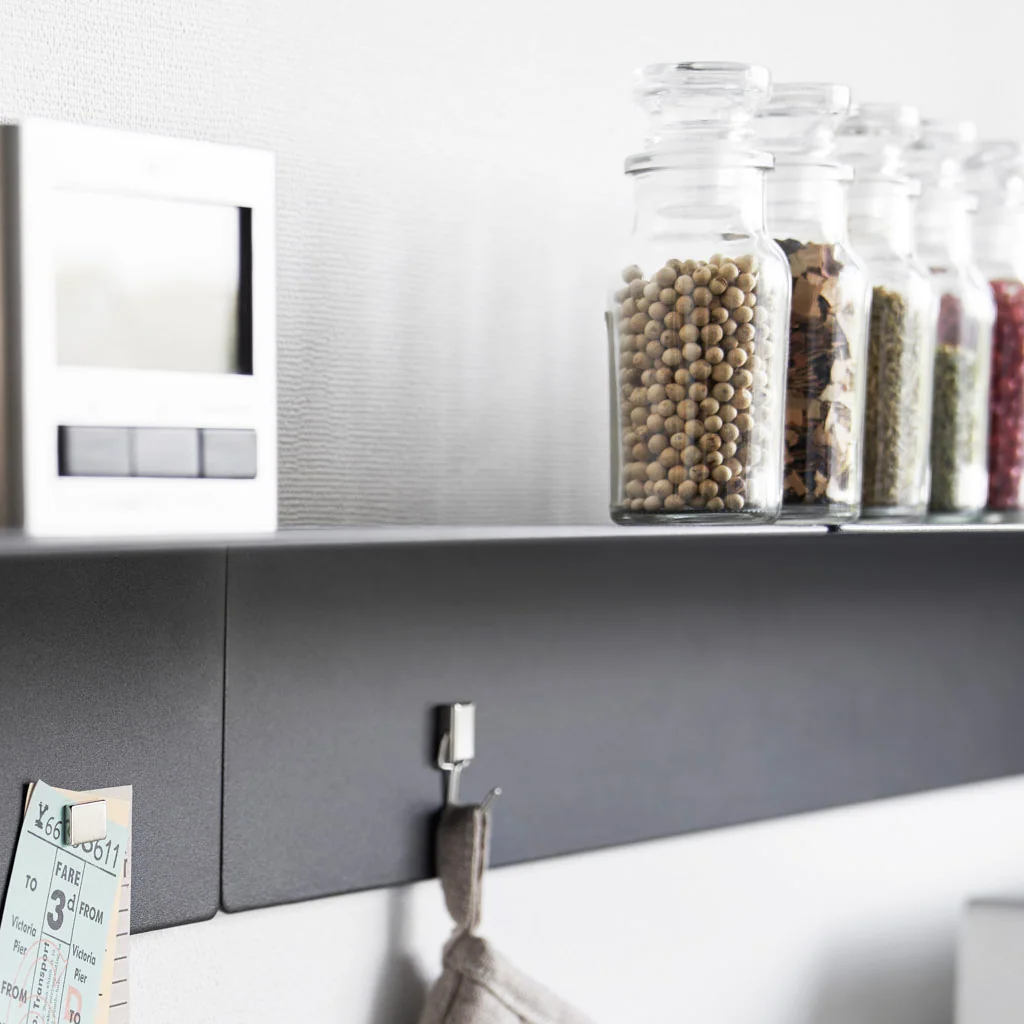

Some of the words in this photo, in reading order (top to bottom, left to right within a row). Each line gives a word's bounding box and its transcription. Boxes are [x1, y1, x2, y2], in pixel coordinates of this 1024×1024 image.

[25, 875, 38, 891] TO
[55, 861, 81, 887] FARE
[78, 901, 104, 925] FROM
[11, 914, 37, 937] Victoria
[12, 939, 28, 957] Pier
[72, 943, 96, 966] Victoria
[33, 942, 50, 1009] Transport
[74, 967, 88, 984] Pier
[1, 980, 27, 1004] FROM
